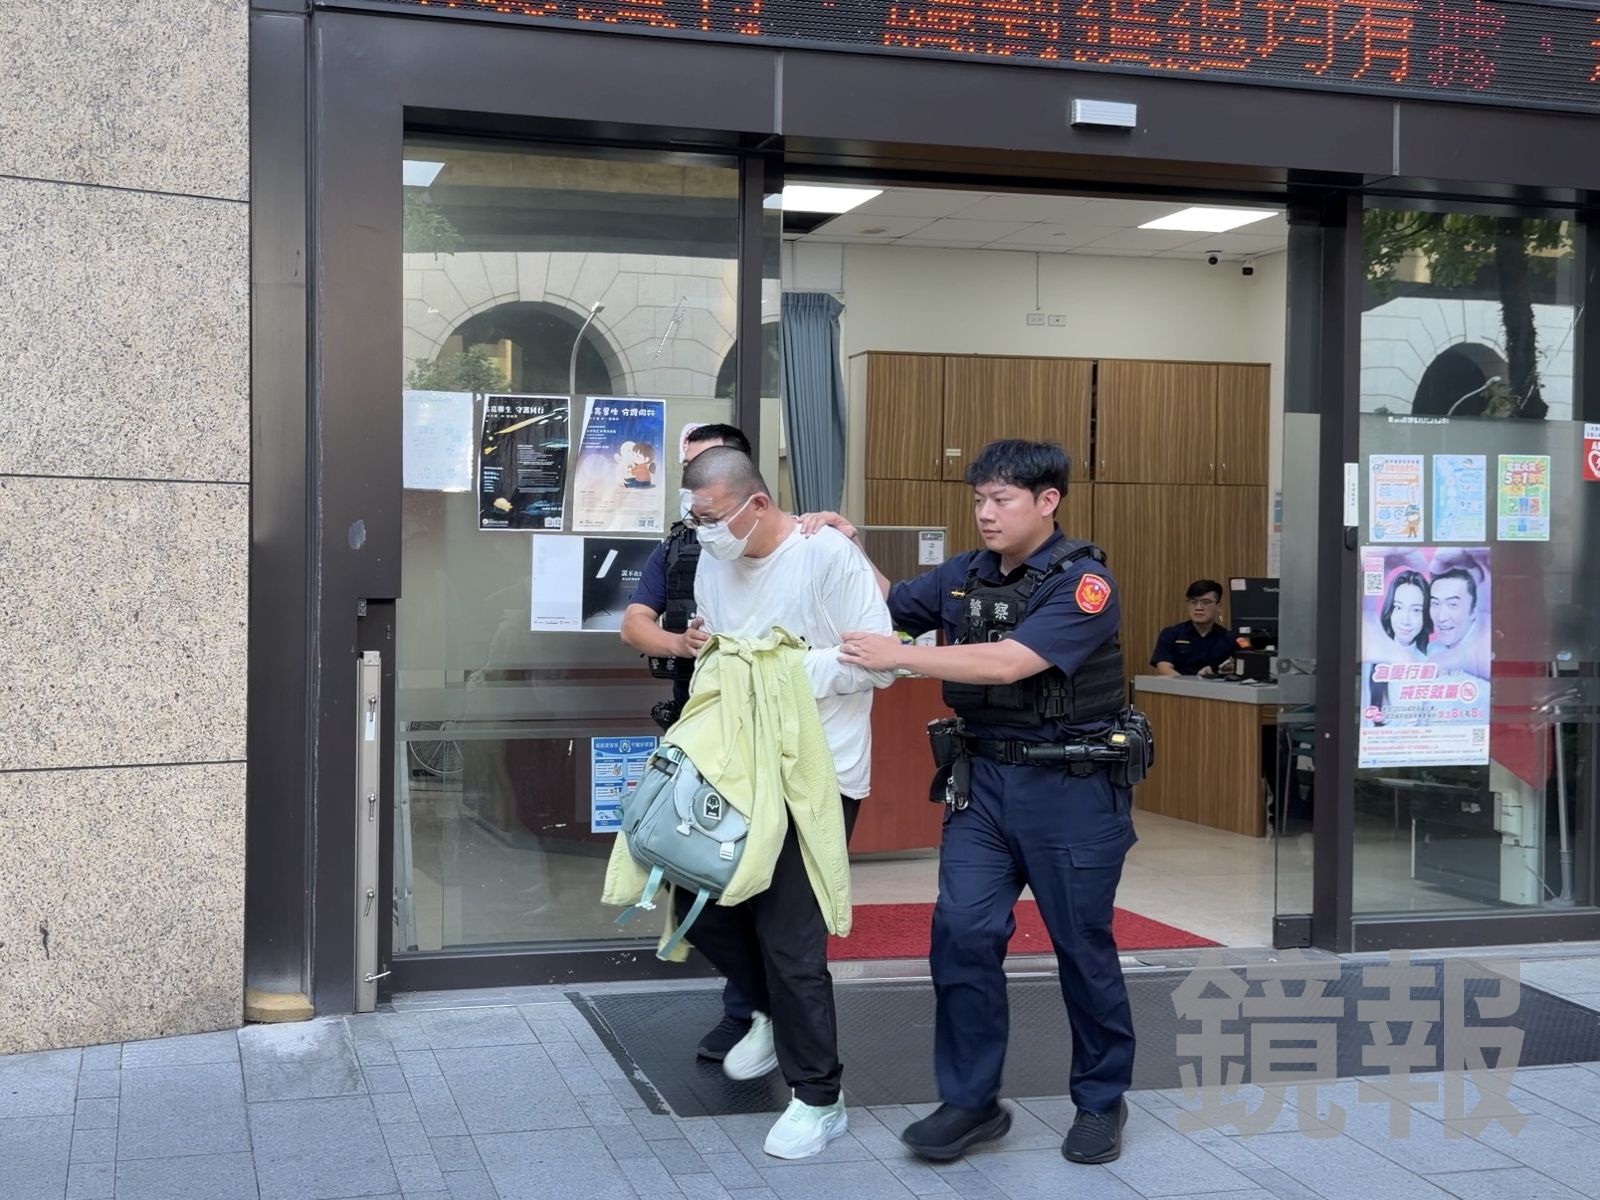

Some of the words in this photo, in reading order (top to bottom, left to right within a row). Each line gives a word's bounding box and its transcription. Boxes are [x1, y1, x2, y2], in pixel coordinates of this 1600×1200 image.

[969, 598, 1009, 621] 警察
[1399, 684, 1460, 701] 戒菸就贏
